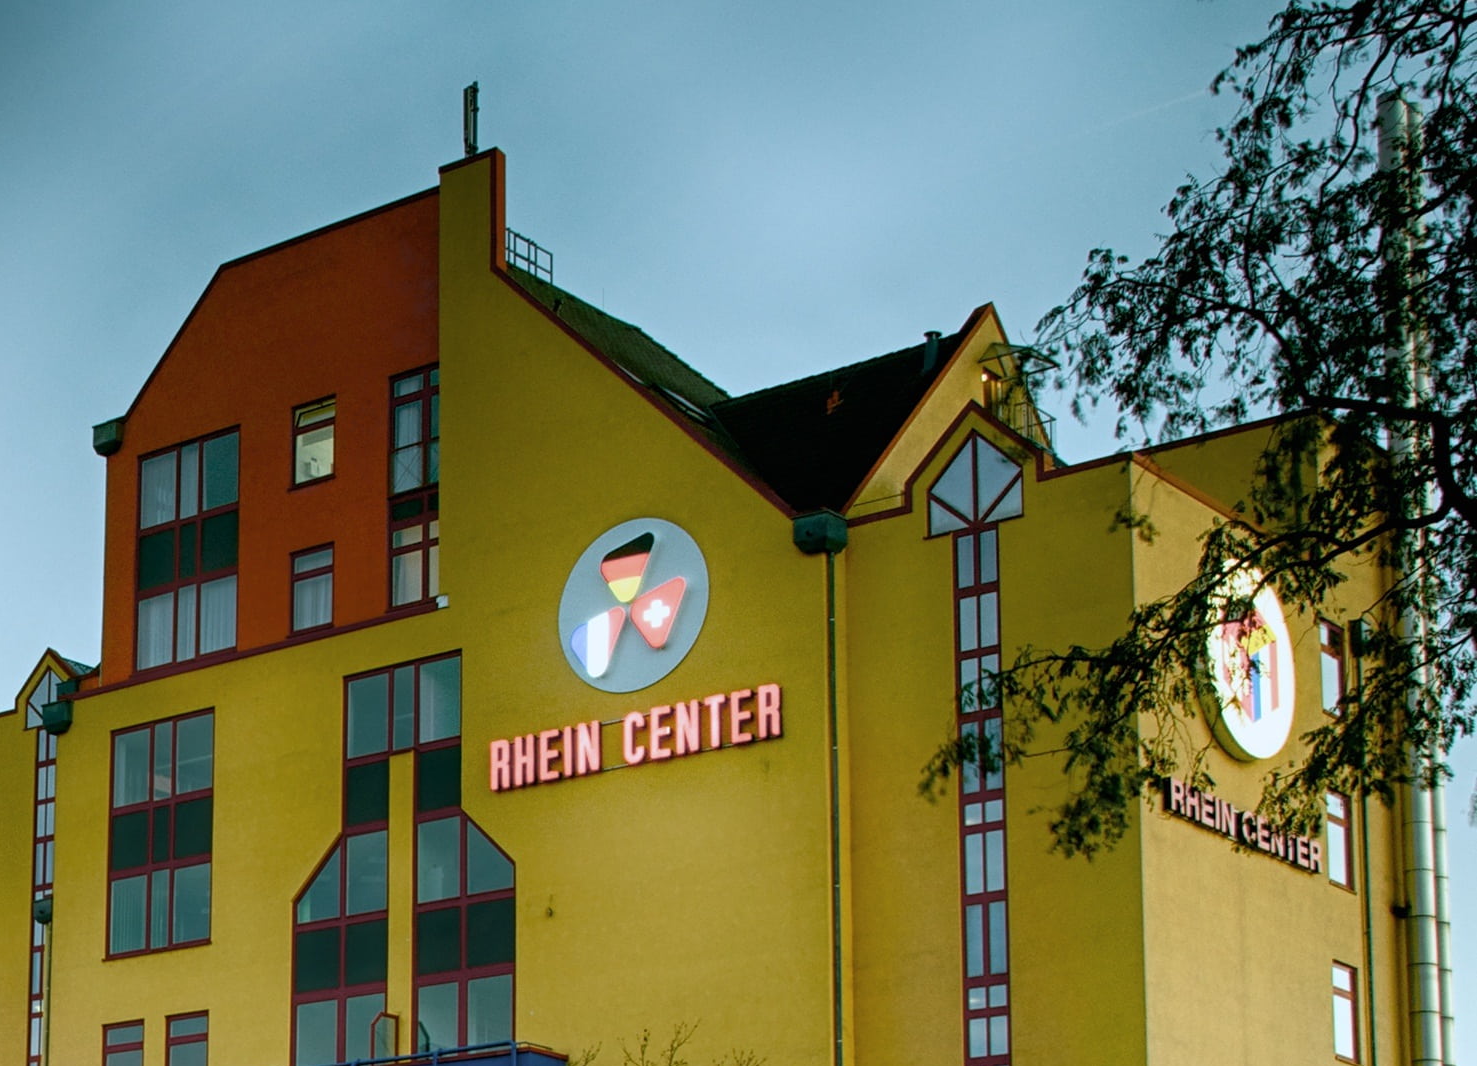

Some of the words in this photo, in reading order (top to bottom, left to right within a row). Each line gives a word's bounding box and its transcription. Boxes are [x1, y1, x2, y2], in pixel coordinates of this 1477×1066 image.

[489, 720, 603, 793] RHEIN
[622, 682, 783, 766] CENTER
[1169, 777, 1237, 841] RHEIN
[1241, 810, 1324, 872] CENTER
